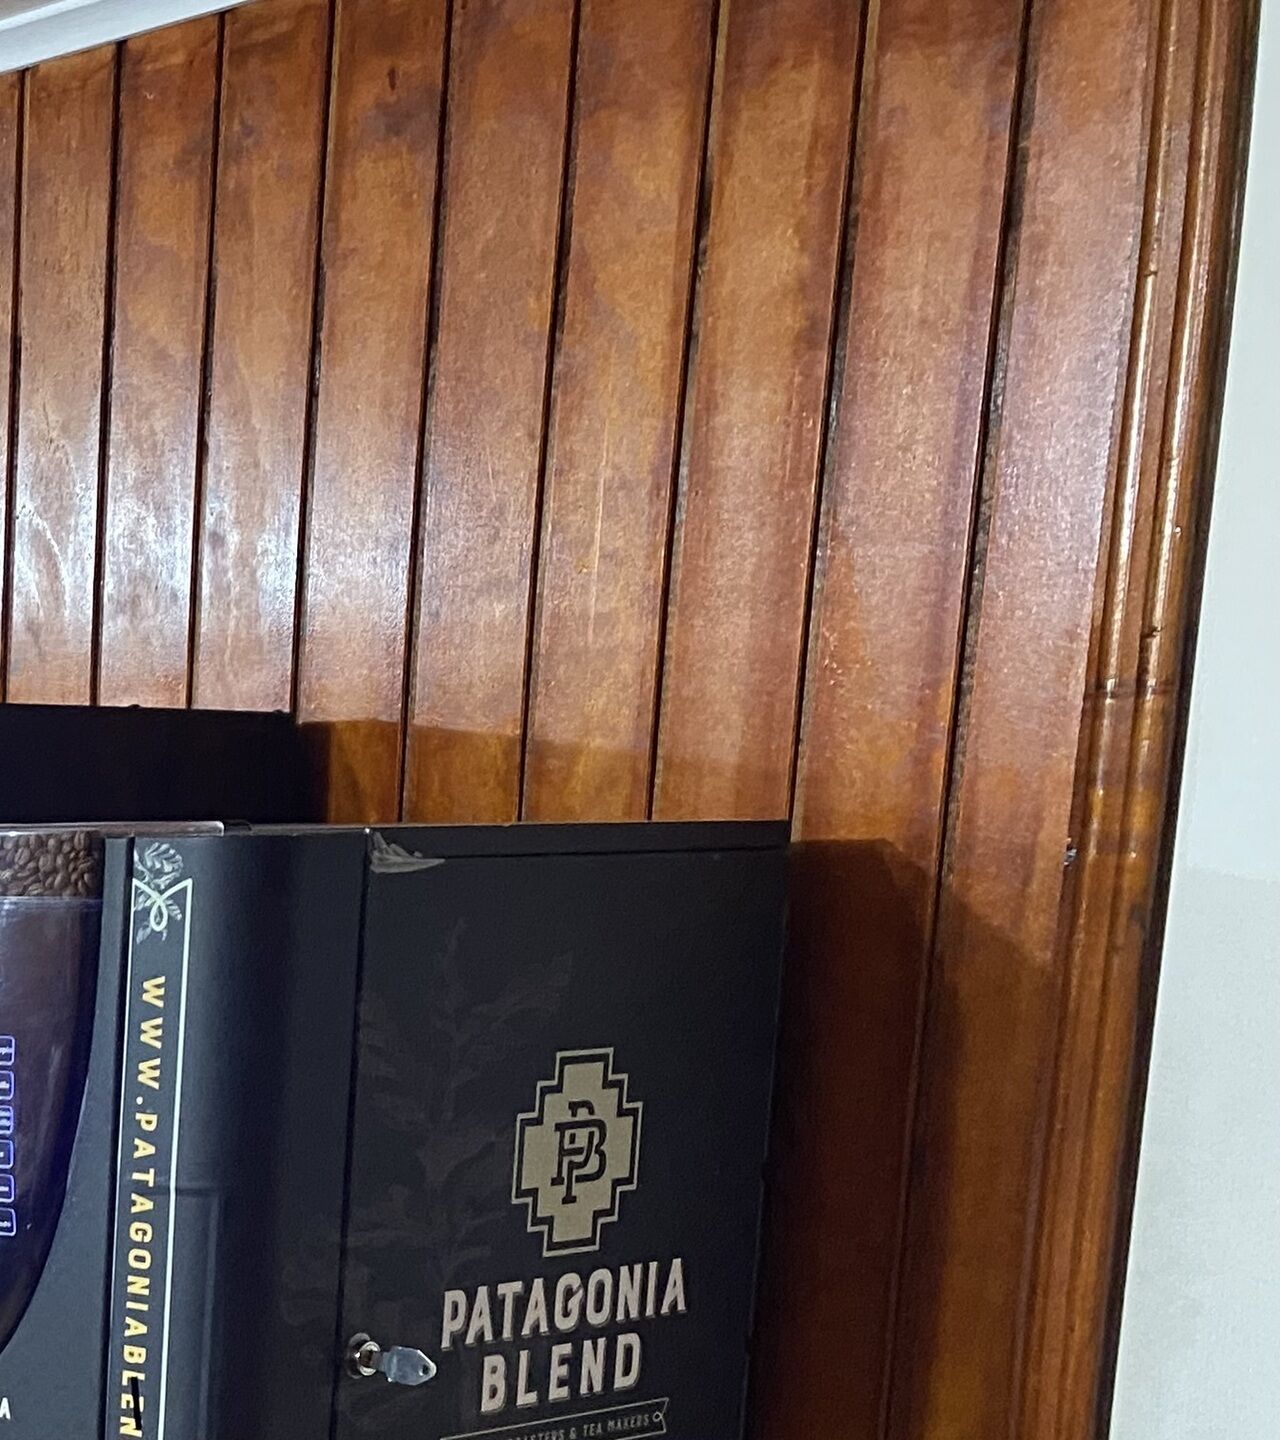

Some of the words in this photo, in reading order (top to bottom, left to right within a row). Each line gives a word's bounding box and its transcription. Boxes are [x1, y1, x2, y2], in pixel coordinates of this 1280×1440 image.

[440, 1257, 687, 1350] PATAGONIA
[480, 1331, 642, 1415] BLEND
[568, 1426, 578, 1440] &
[582, 1422, 603, 1438] TEA
[607, 1413, 650, 1433] MAKERS
